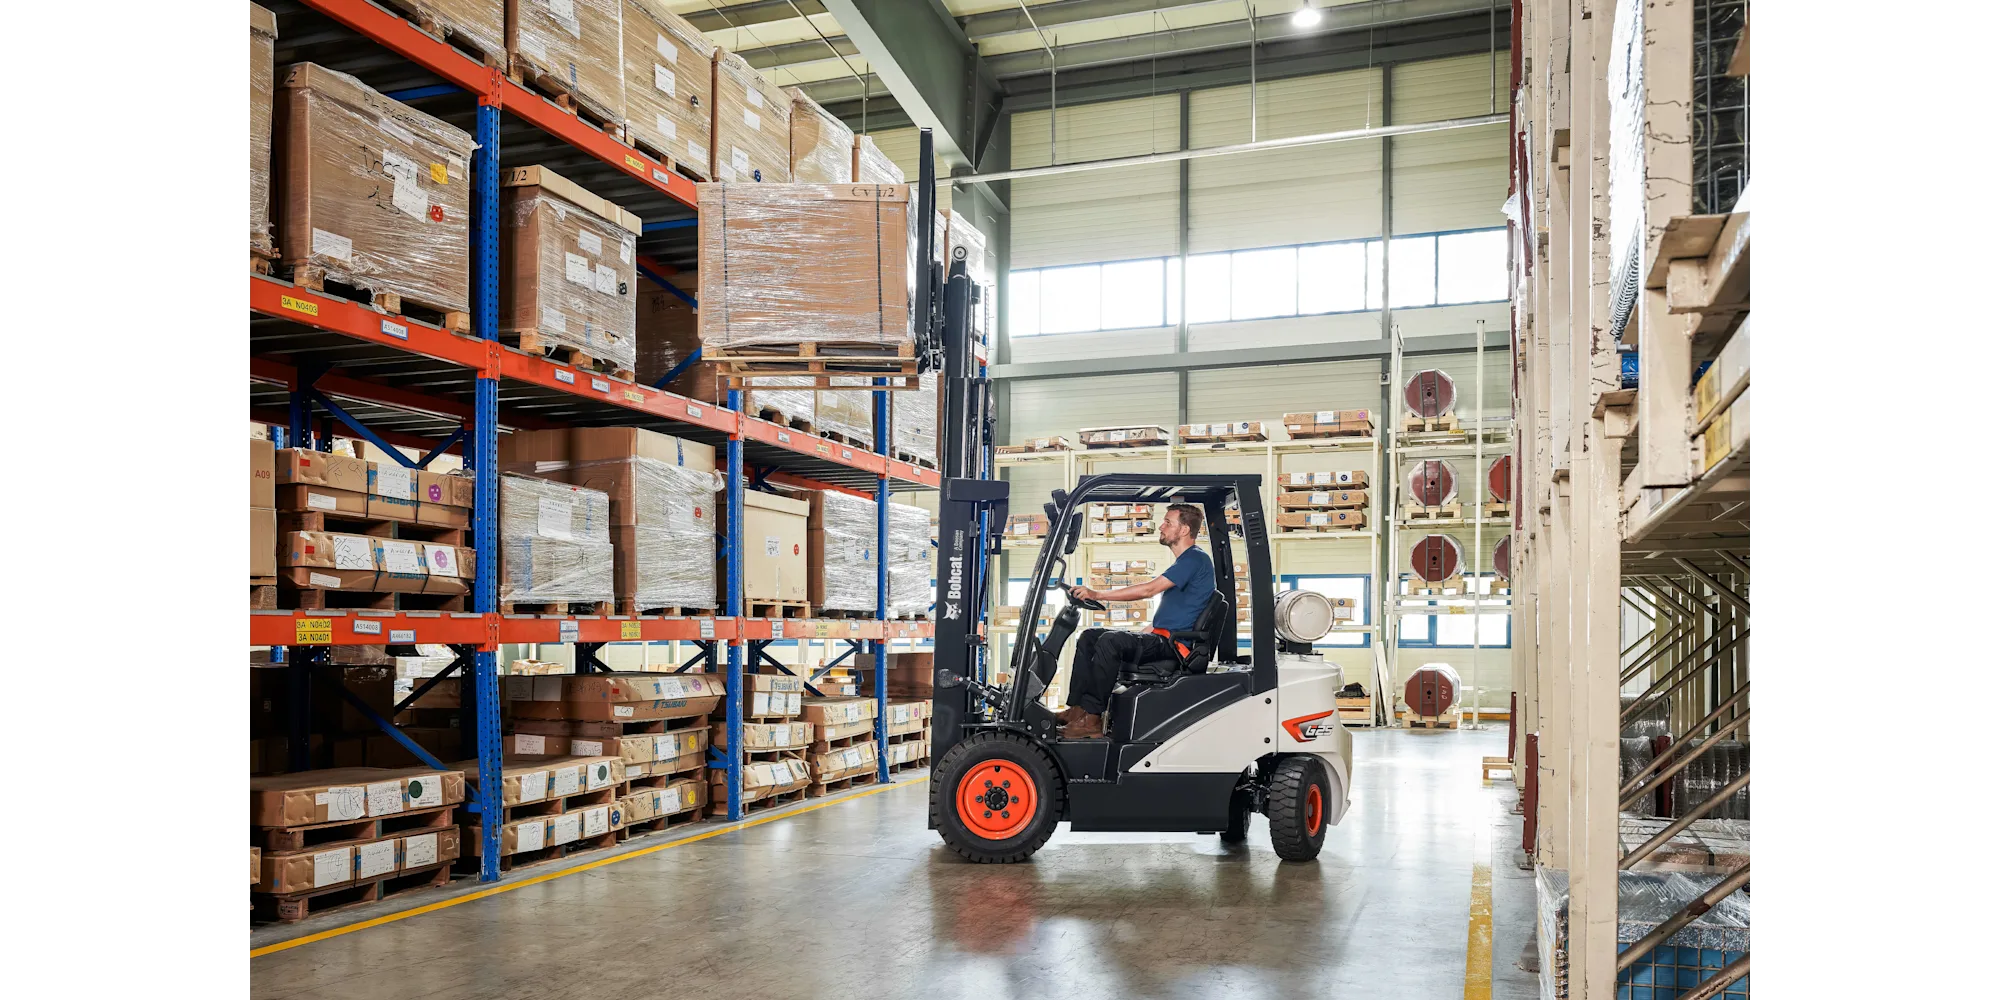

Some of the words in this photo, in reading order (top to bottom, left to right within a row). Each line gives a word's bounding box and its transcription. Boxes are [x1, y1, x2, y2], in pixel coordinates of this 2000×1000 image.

[511, 169, 527, 182] 1/2
[282, 297, 292, 306] 3A
[296, 301, 318, 313] N0403
[255, 469, 270, 479] A09
[310, 621, 331, 629] N0402
[355, 623, 379, 631] A514008
[298, 633, 307, 642] 3A
[309, 633, 330, 642] N0401
[1305, 725, 1335, 737] G25
